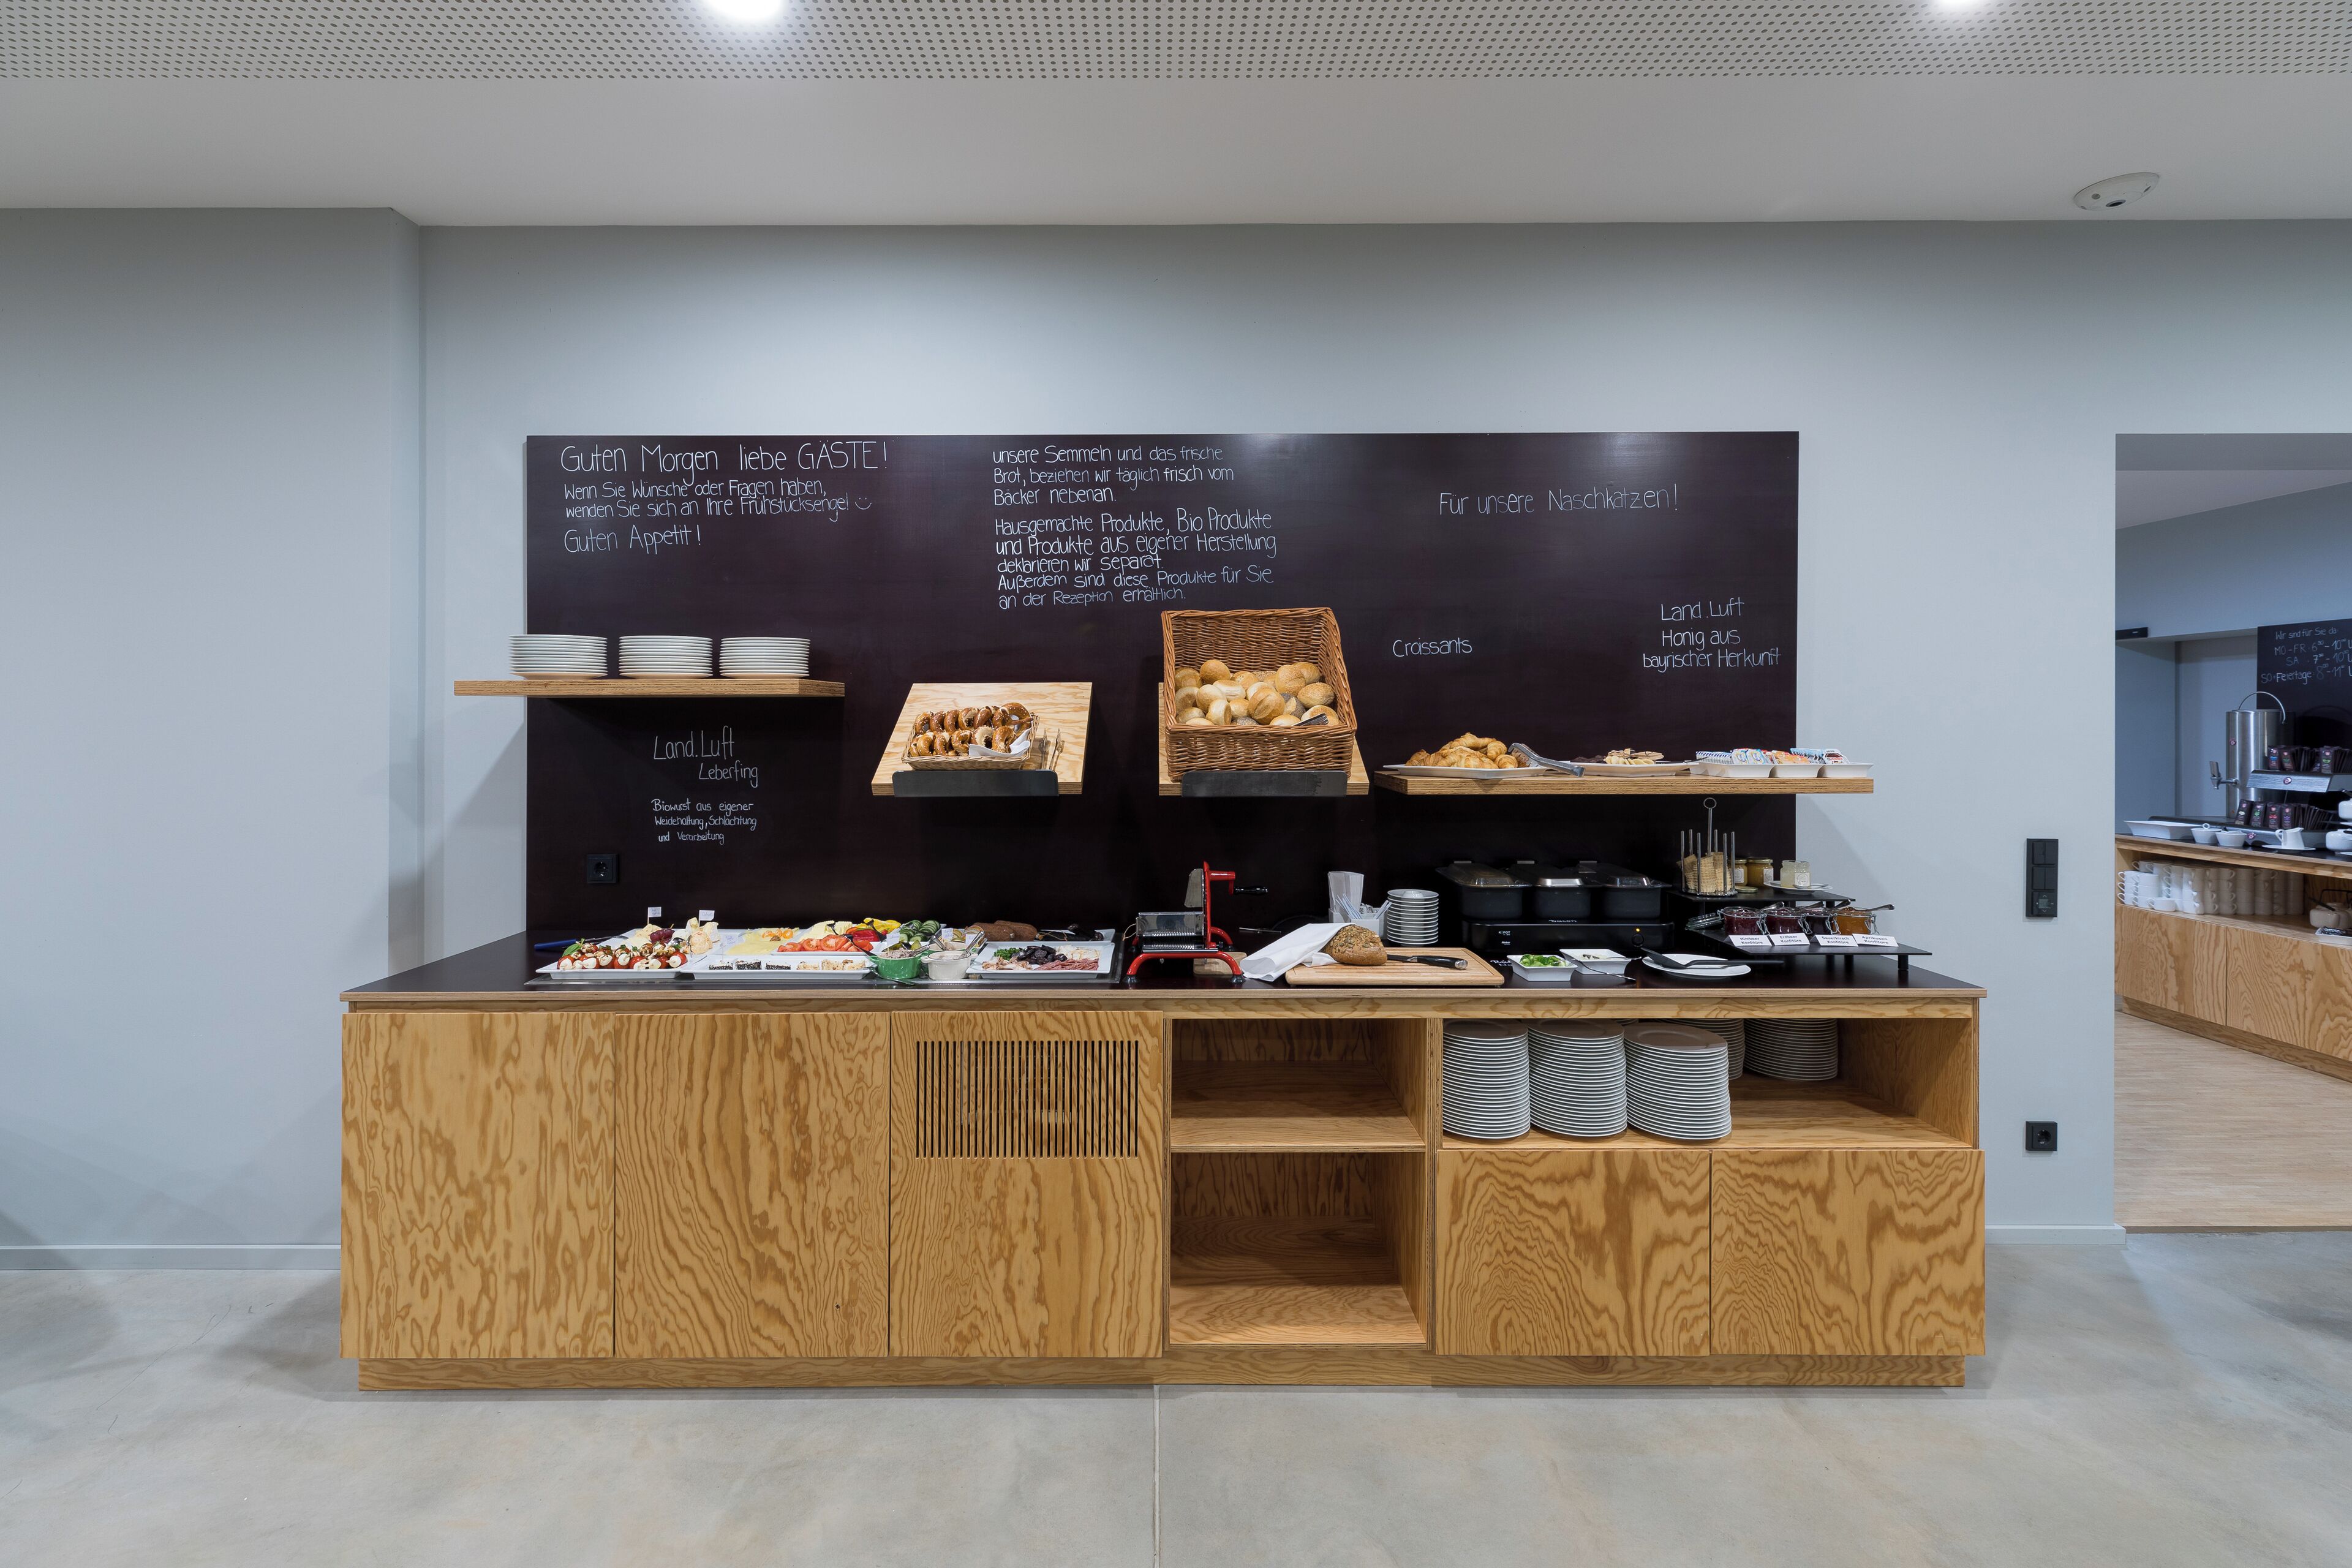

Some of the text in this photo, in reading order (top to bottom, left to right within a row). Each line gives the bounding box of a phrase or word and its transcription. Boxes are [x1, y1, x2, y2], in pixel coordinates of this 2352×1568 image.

[561, 445, 627, 472] Guten
[641, 445, 718, 485] Morgen
[739, 444, 786, 470] liebe
[993, 445, 1223, 463] unsere Semmeln und das frische
[564, 477, 826, 500] Wenn Sie Wünsche oder Fragen haben,
[994, 465, 1234, 490] Brot, beziehen wir täglich frisch vom
[566, 492, 849, 522] wenden Sie sich an Ihre Frühstücksengel
[994, 488, 1117, 505] Bäcker nebenan.
[1439, 492, 1469, 515] Für
[1477, 494, 1534, 514] unsere
[995, 507, 1272, 537] Hausgemachte Produkte, Bio Produkte
[565, 528, 618, 552] Guten
[996, 533, 1276, 558] und Produkte aus eigener Herstellung
[997, 557, 1069, 573] deklarieren
[1075, 559, 1091, 571] wir
[998, 565, 1274, 593] Außerdem sind diese Produkte für Sie
[999, 587, 1186, 609] an der Rezeption erhältlich.
[1662, 627, 1741, 651] Honig aus
[2276, 631, 2286, 640] Wir
[2315, 627, 2326, 636] Sie
[1393, 637, 1472, 657] Croissants
[2275, 646, 2286, 656] MO
[1643, 647, 1781, 673] bayrischer Herkunft
[699, 760, 758, 788] Leberfing
[651, 797, 754, 816] Biowurst aus eigener
[658, 830, 724, 845] und Verarbeitung
